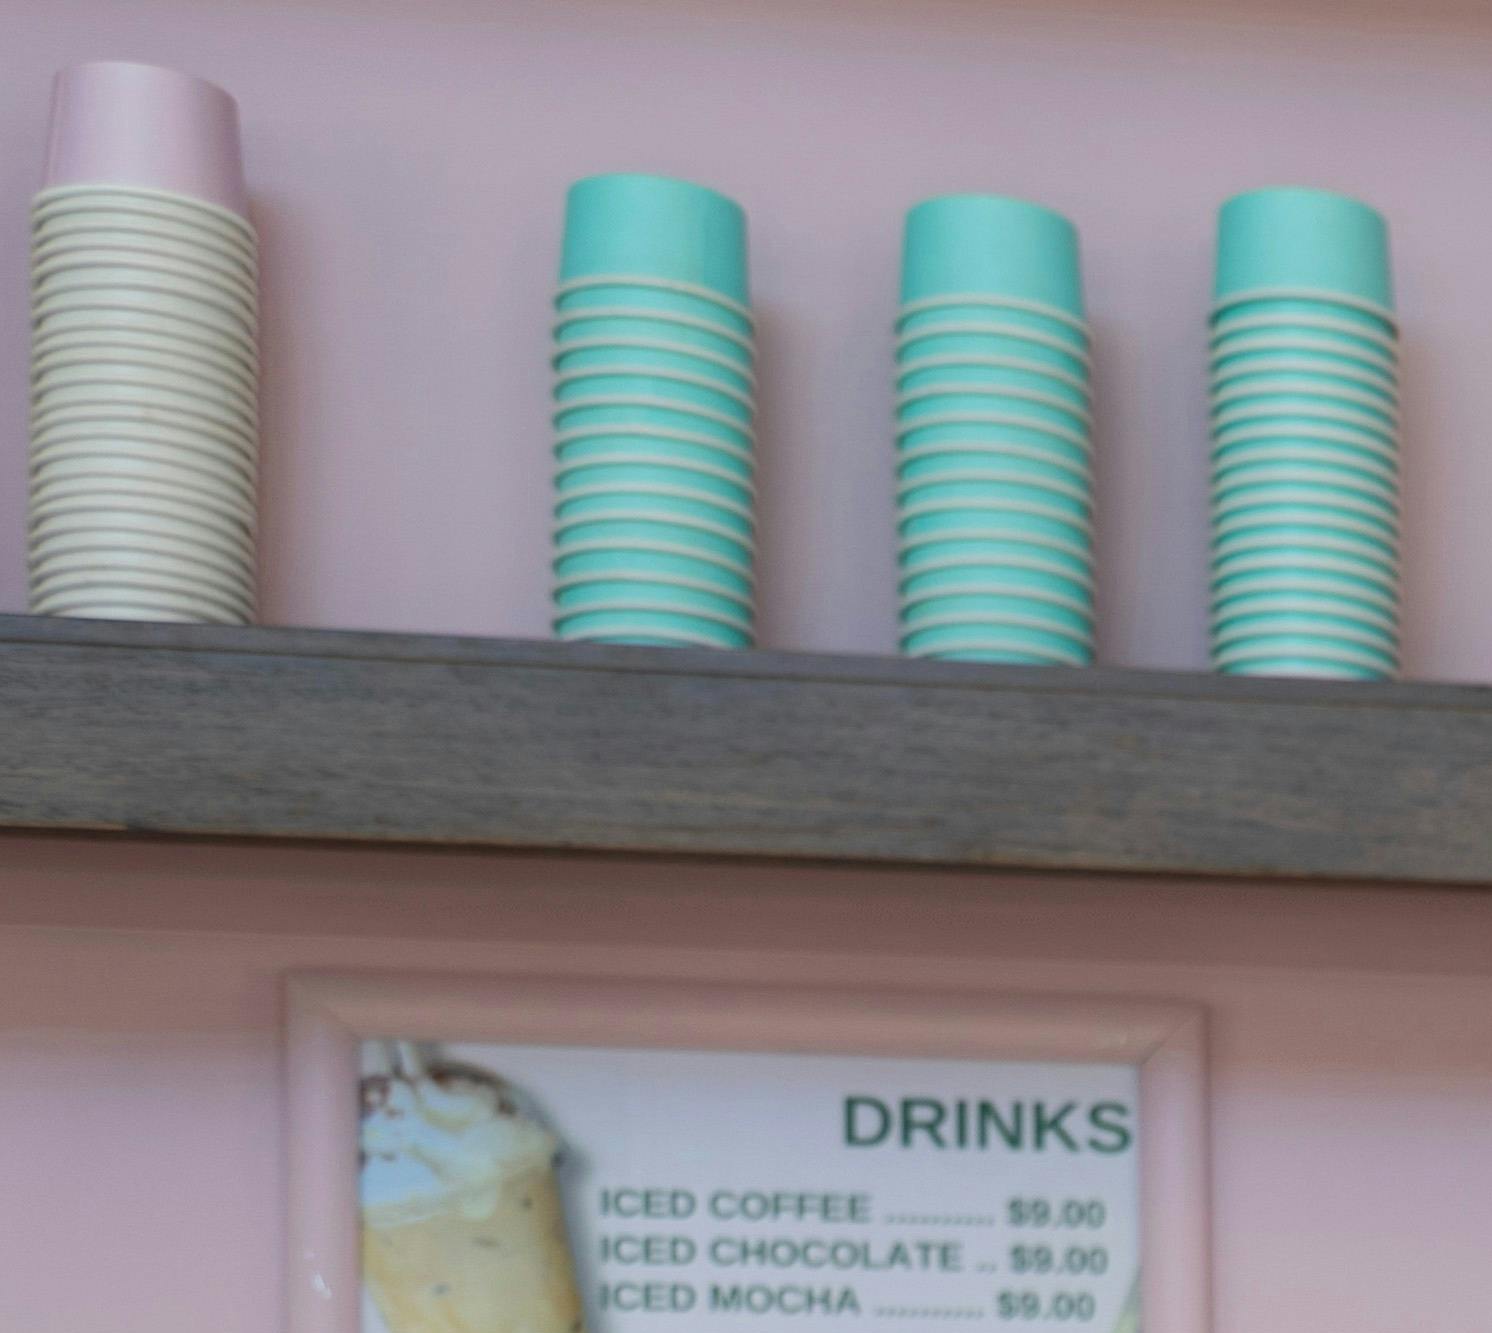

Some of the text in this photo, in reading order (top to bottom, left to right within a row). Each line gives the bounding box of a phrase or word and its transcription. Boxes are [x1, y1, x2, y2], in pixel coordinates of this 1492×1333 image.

[842, 1094, 1133, 1155] DRINKS
[598, 1187, 1106, 1229] ICED COFFEE $9.00
[598, 1235, 1109, 1275] ICED CHOCOLATE $9.00
[598, 1282, 1096, 1322] ICED MOCHA $9.00
